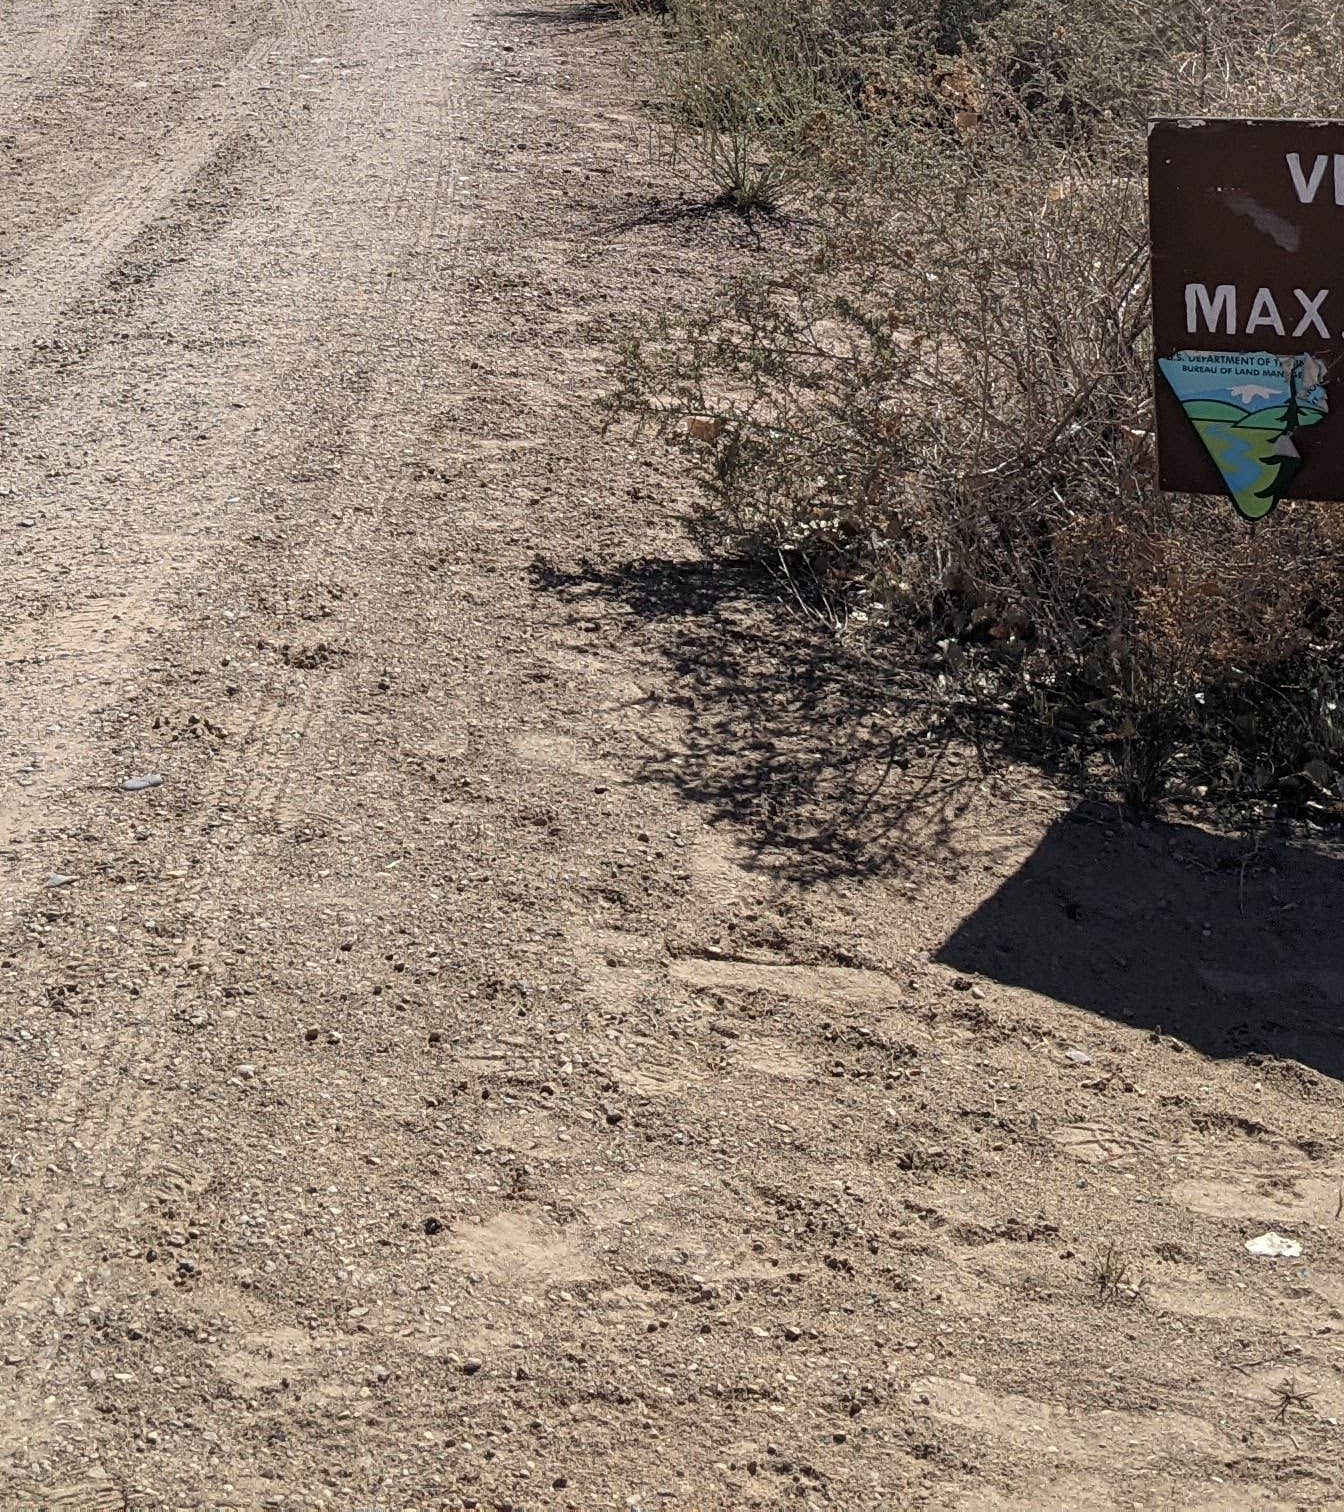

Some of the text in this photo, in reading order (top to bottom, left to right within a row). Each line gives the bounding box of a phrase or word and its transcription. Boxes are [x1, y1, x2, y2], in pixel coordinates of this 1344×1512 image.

[1257, 357, 1270, 366] OF
[1182, 365, 1217, 374] BUREAU
[1220, 367, 1233, 375] OF
[1234, 368, 1260, 376] LAND
